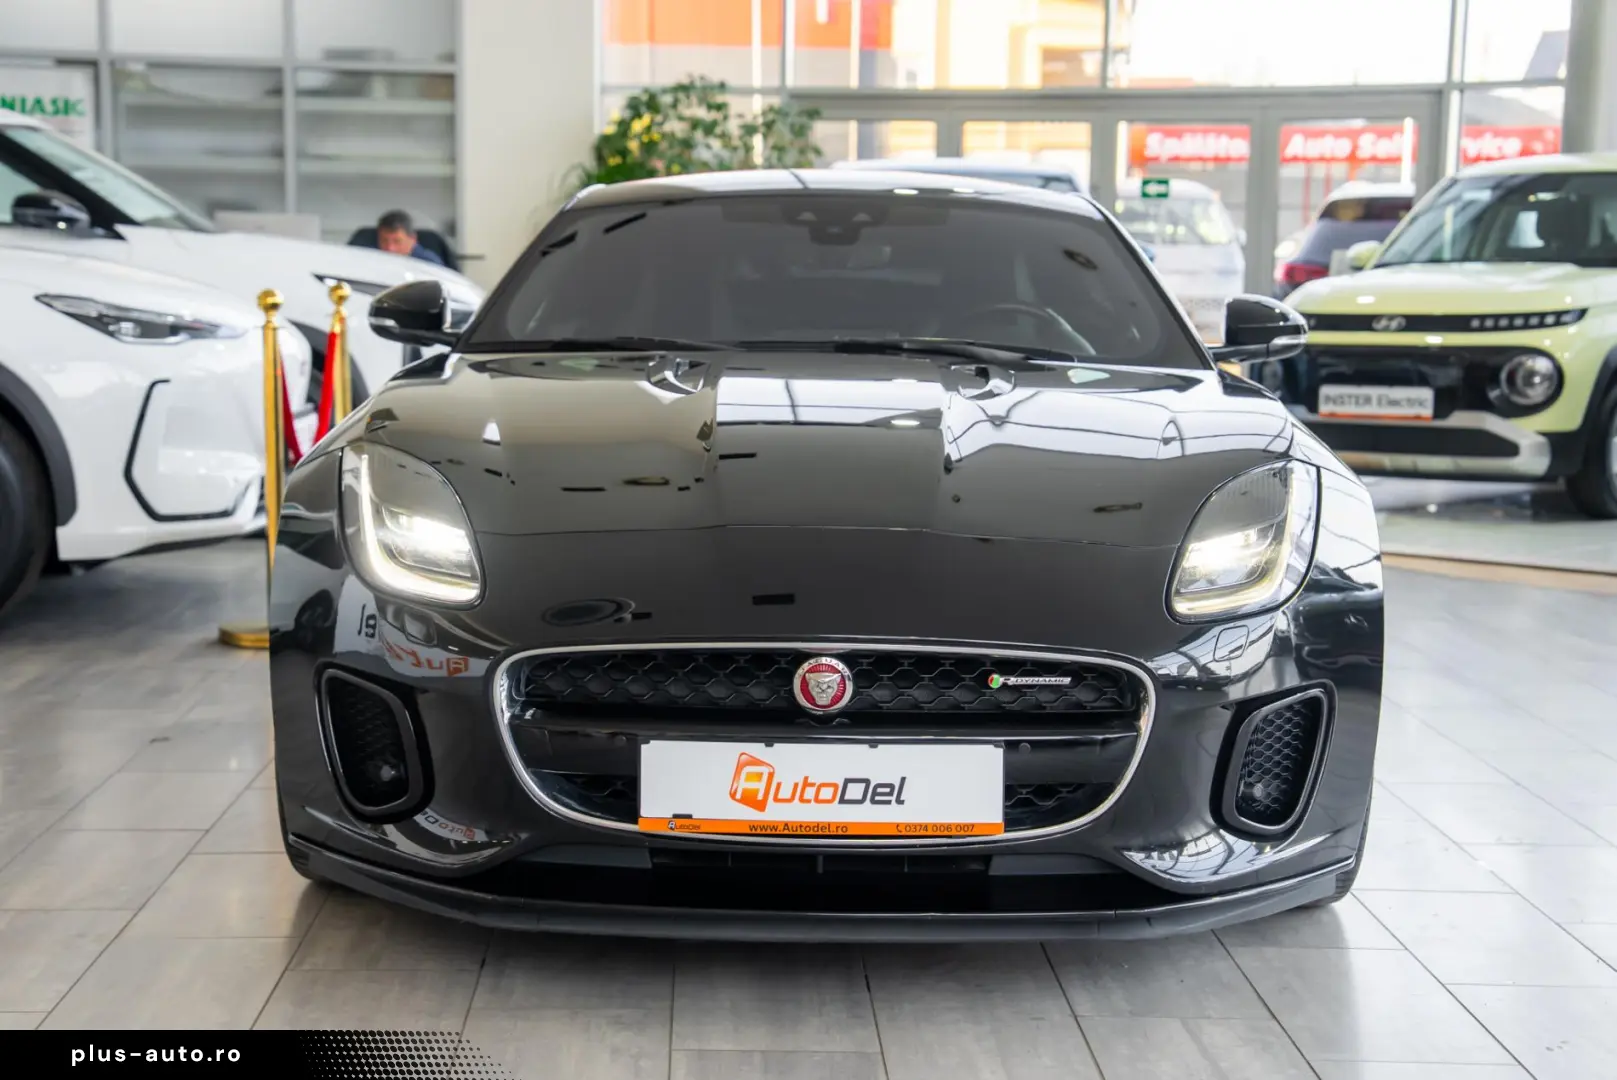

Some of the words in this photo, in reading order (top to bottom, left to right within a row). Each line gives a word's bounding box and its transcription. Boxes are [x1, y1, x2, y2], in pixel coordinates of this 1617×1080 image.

[1284, 133, 1353, 158] Auto
[729, 752, 906, 812] AutoDel
[749, 822, 848, 834] www.Autodel.ro
[904, 824, 929, 833] 0374
[931, 824, 952, 833] 006
[955, 824, 975, 833] 007
